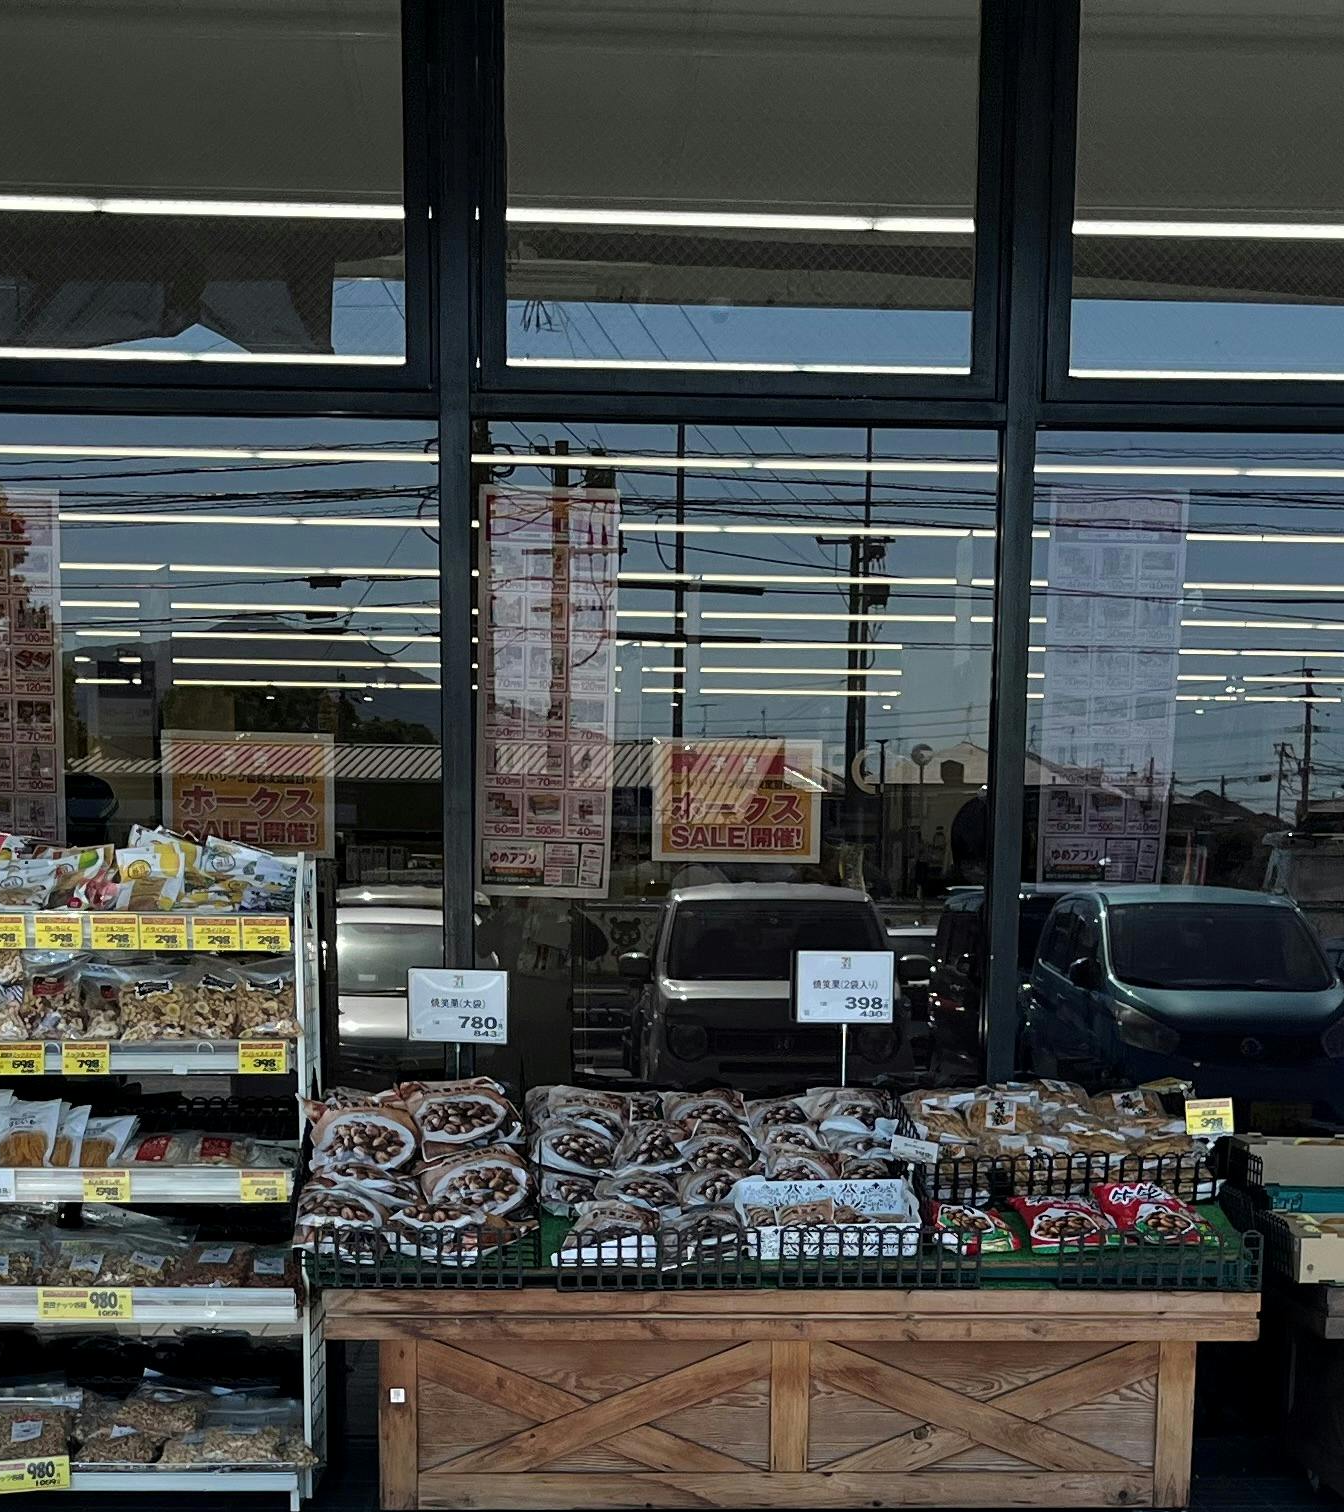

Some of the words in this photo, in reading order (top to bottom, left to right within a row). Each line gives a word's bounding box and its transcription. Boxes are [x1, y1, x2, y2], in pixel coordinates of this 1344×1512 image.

[180, 784, 318, 819] ホークス
[671, 791, 804, 825] ホークス
[670, 825, 803, 849] SALE開催!
[844, 996, 883, 1010] 398
[458, 1016, 498, 1029] 780
[89, 1291, 118, 1309] 980
[27, 1461, 55, 1479] 980
